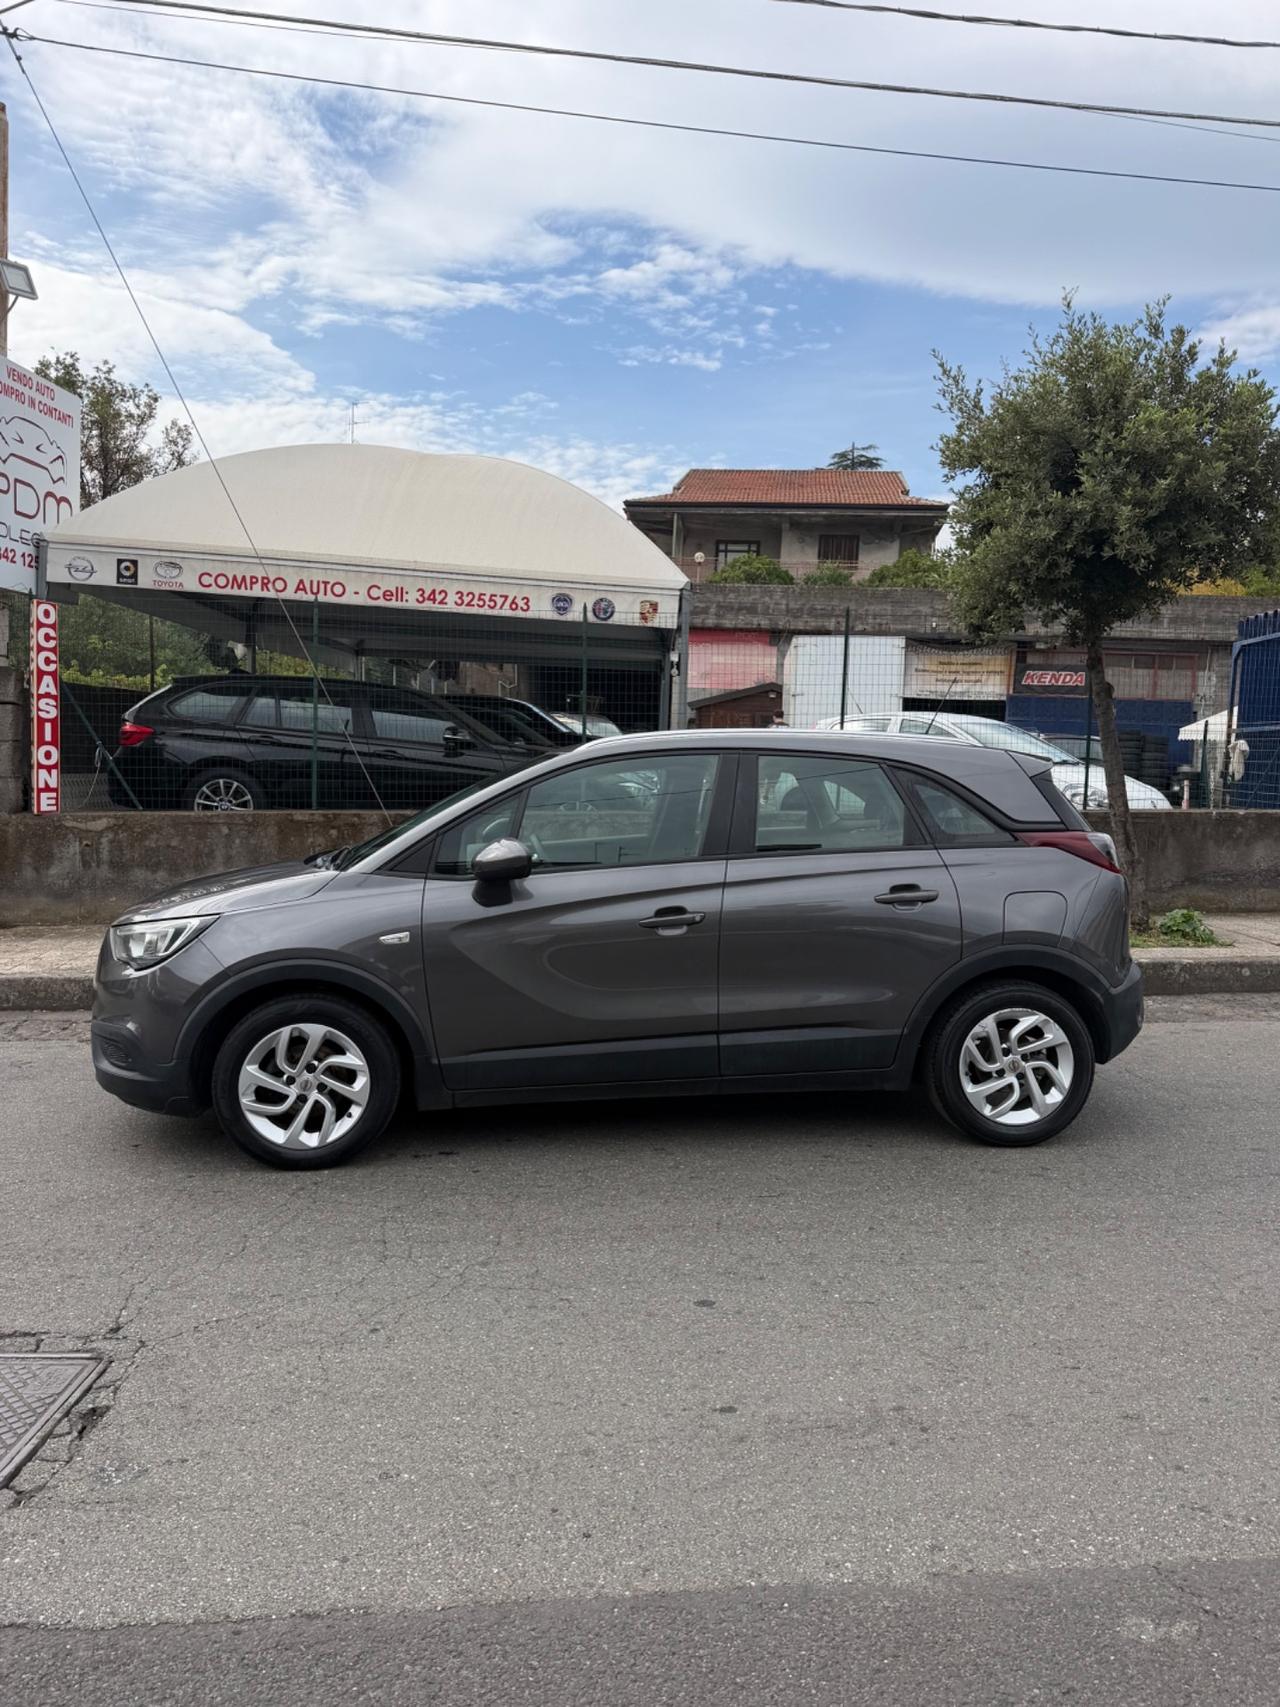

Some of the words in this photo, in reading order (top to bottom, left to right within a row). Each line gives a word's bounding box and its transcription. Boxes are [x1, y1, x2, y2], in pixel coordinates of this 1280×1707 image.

[6, 365, 33, 390] VENDO
[35, 381, 55, 401] AUTO
[28, 395, 36, 410] IN
[37, 400, 74, 428] CONTANTI
[0, 546, 17, 564] 42
[152, 579, 184, 589] TOYOTA
[197, 571, 288, 594] COMPRO
[294, 577, 347, 598] AUTO
[366, 584, 409, 603] Cell:
[415, 587, 448, 606] 342
[454, 590, 531, 612] 3255763
[1021, 670, 1086, 687] KENDA
[36, 603, 59, 812] OCCASIONE
